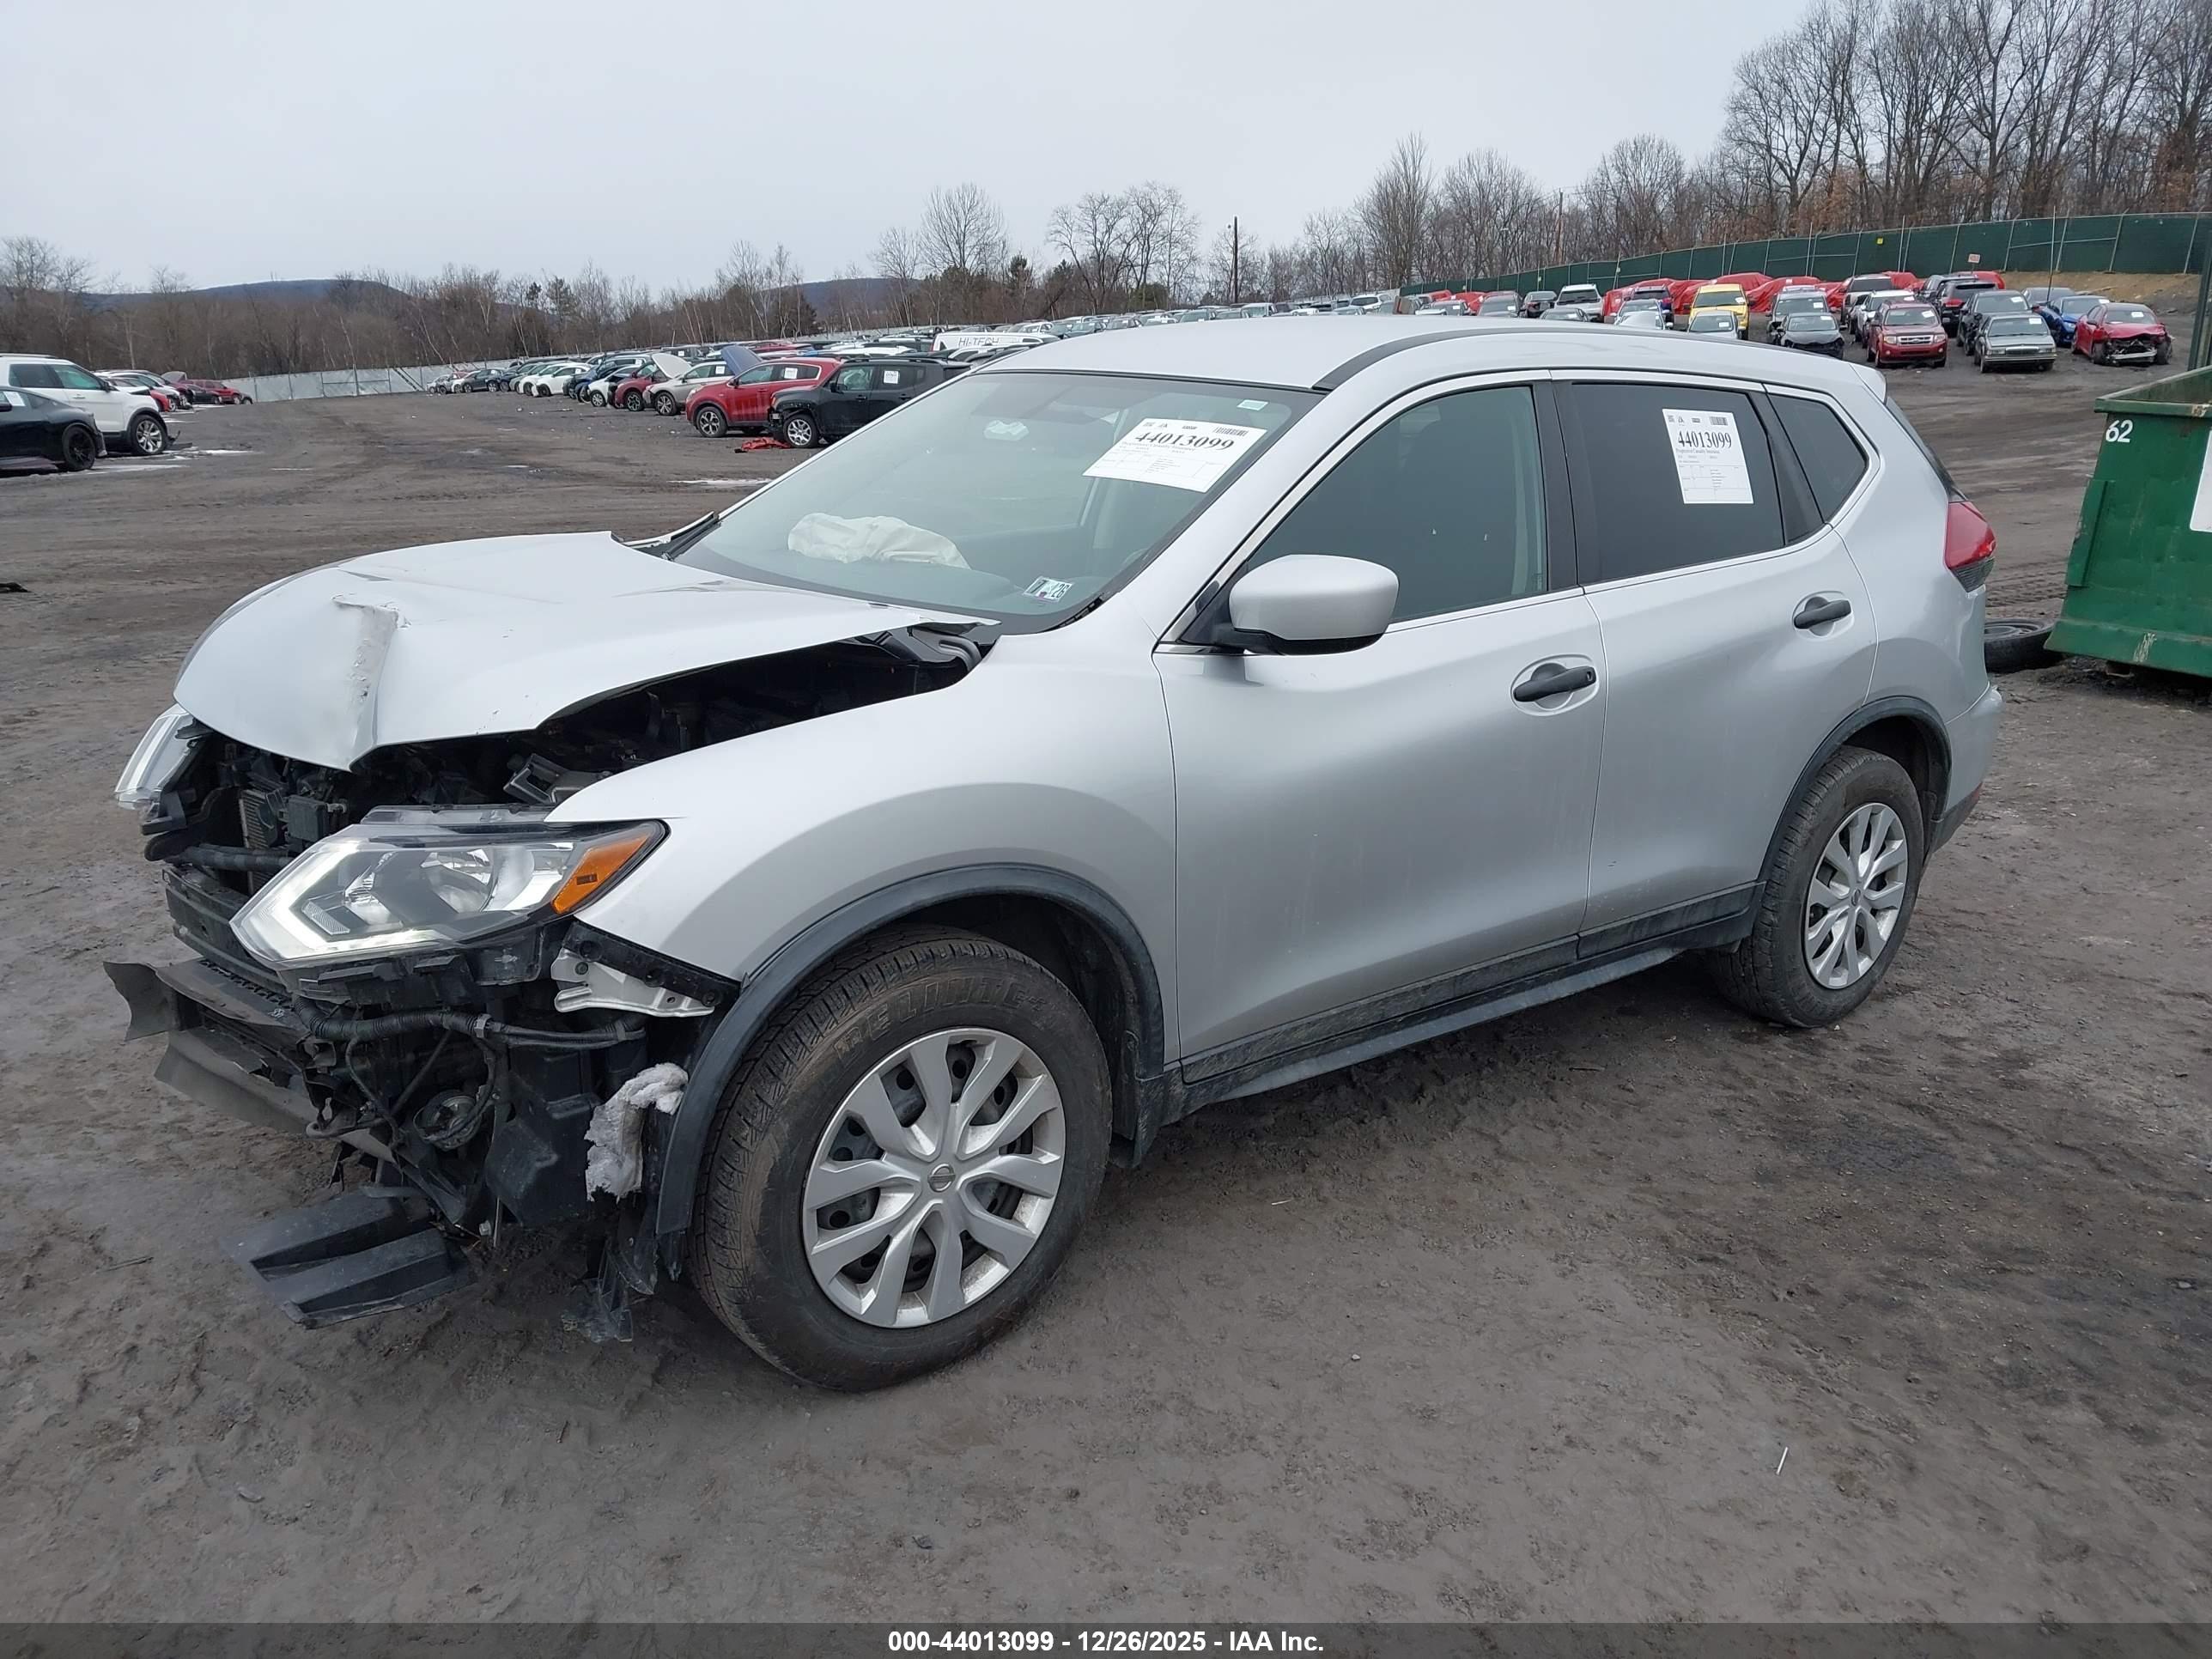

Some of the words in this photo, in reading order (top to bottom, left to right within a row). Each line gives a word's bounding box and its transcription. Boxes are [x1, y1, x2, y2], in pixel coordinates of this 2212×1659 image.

[1134, 431, 1235, 451] 44013099
[1678, 430, 1732, 448] 44013099
[2106, 419, 2133, 443] 62
